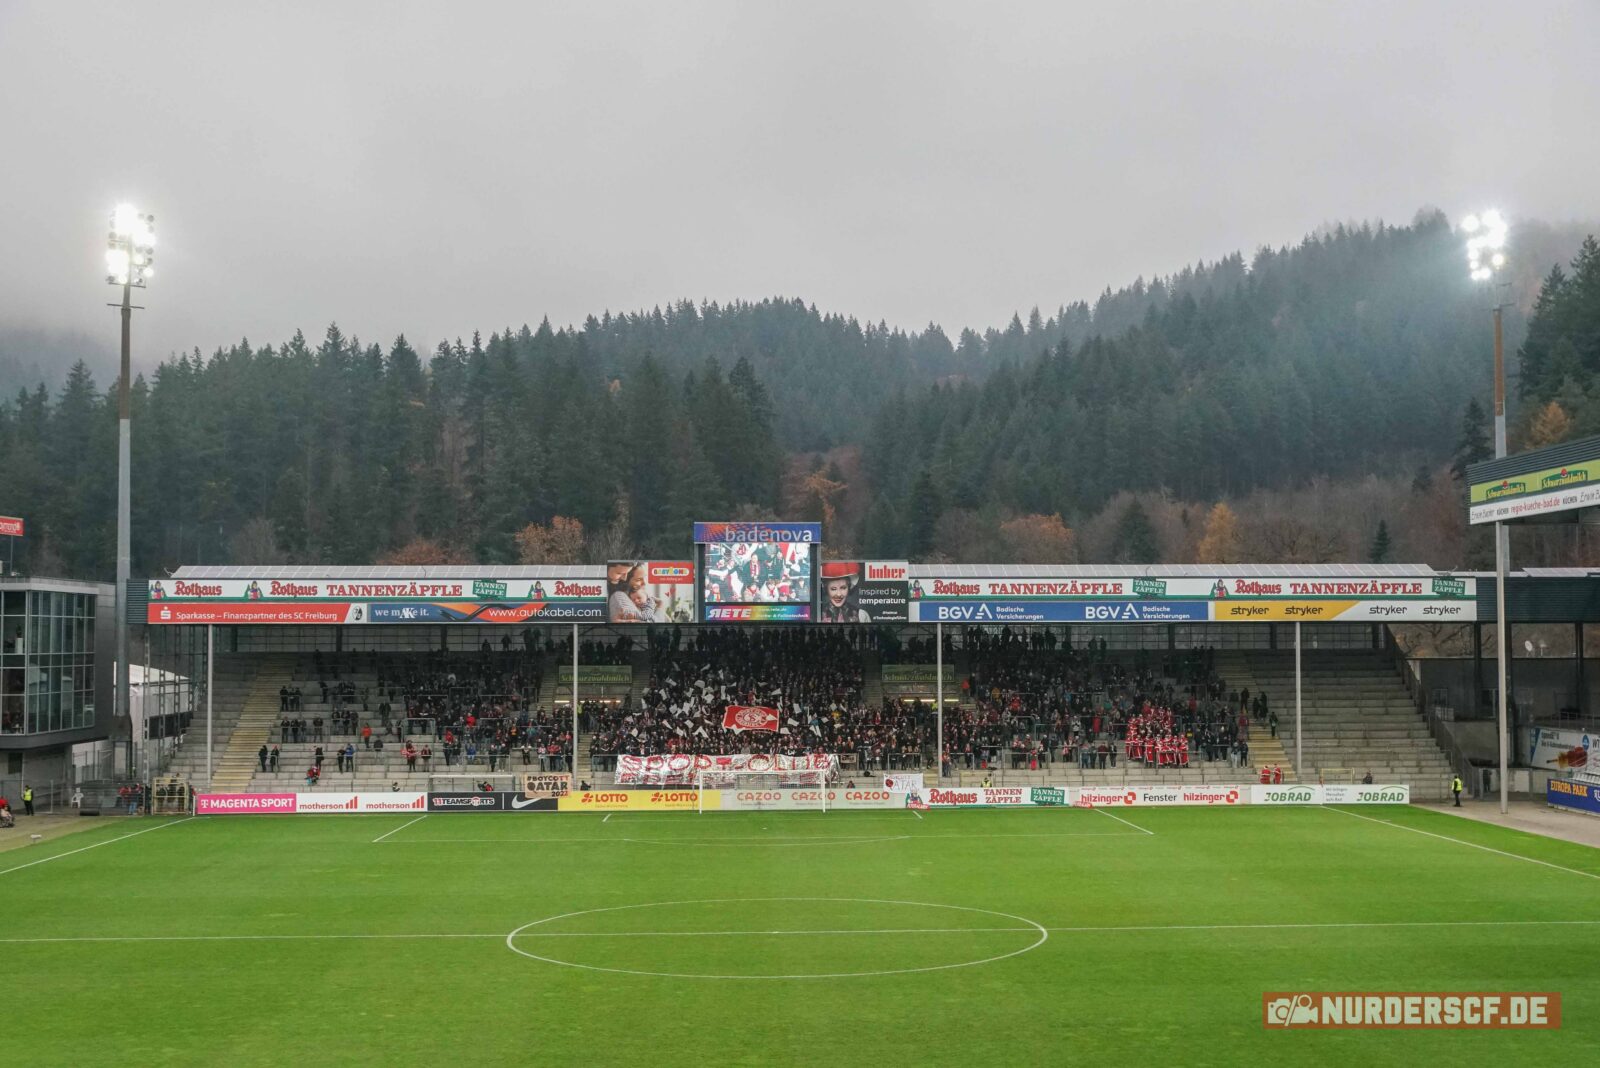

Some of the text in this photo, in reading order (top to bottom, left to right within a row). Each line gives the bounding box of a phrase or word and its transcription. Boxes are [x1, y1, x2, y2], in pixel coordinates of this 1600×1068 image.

[725, 525, 813, 542] badenova
[869, 564, 906, 579] huber
[474, 581, 507, 590] TANNEN
[932, 579, 1122, 597] Rothaus TANNENZÄPFLE
[1134, 580, 1165, 588] TANNEN
[1234, 579, 1422, 596] Rothaus TANNENZÄPFLE
[1434, 579, 1465, 587] TANNEN
[174, 580, 222, 597] Rothaus
[270, 580, 462, 598] Rothaus TANNENZÄPFLE
[554, 580, 602, 597] Rothaus
[859, 588, 901, 596] Inspired by
[859, 598, 906, 606] temperature
[375, 609, 390, 617] we
[419, 608, 430, 617] it.
[488, 608, 602, 617] www.autokabel.com
[938, 606, 973, 619] BGV
[1085, 606, 1121, 619] BGV
[1231, 606, 1270, 616] stryker
[1284, 606, 1323, 616] stryker
[1369, 605, 1408, 615] stryker
[1422, 606, 1461, 616] stryker
[176, 612, 215, 620] Sparkasse
[223, 612, 276, 620] Finanzpartner
[305, 612, 337, 621] Freiburg
[527, 782, 568, 793] QATAR
[984, 788, 1022, 796] TANNEN
[1033, 788, 1063, 796] TANNEN
[1550, 781, 1588, 797] EUROPA PARK
[595, 793, 628, 802] LOTTO
[665, 792, 698, 801] LOTTO
[736, 792, 782, 801] CAZOO
[845, 791, 890, 800] CAZOO
[929, 788, 977, 805] Rothaus
[985, 795, 1021, 803] ZÄPFLE
[1081, 792, 1225, 804] hilzinger Fenster hilzinger
[1264, 791, 1312, 802] JOBRAD
[1356, 792, 1405, 802] JOBRAD
[210, 799, 260, 808] MAGENTA
[261, 798, 293, 808] SPORT
[299, 802, 344, 810] motherson
[366, 801, 410, 809] motherson
